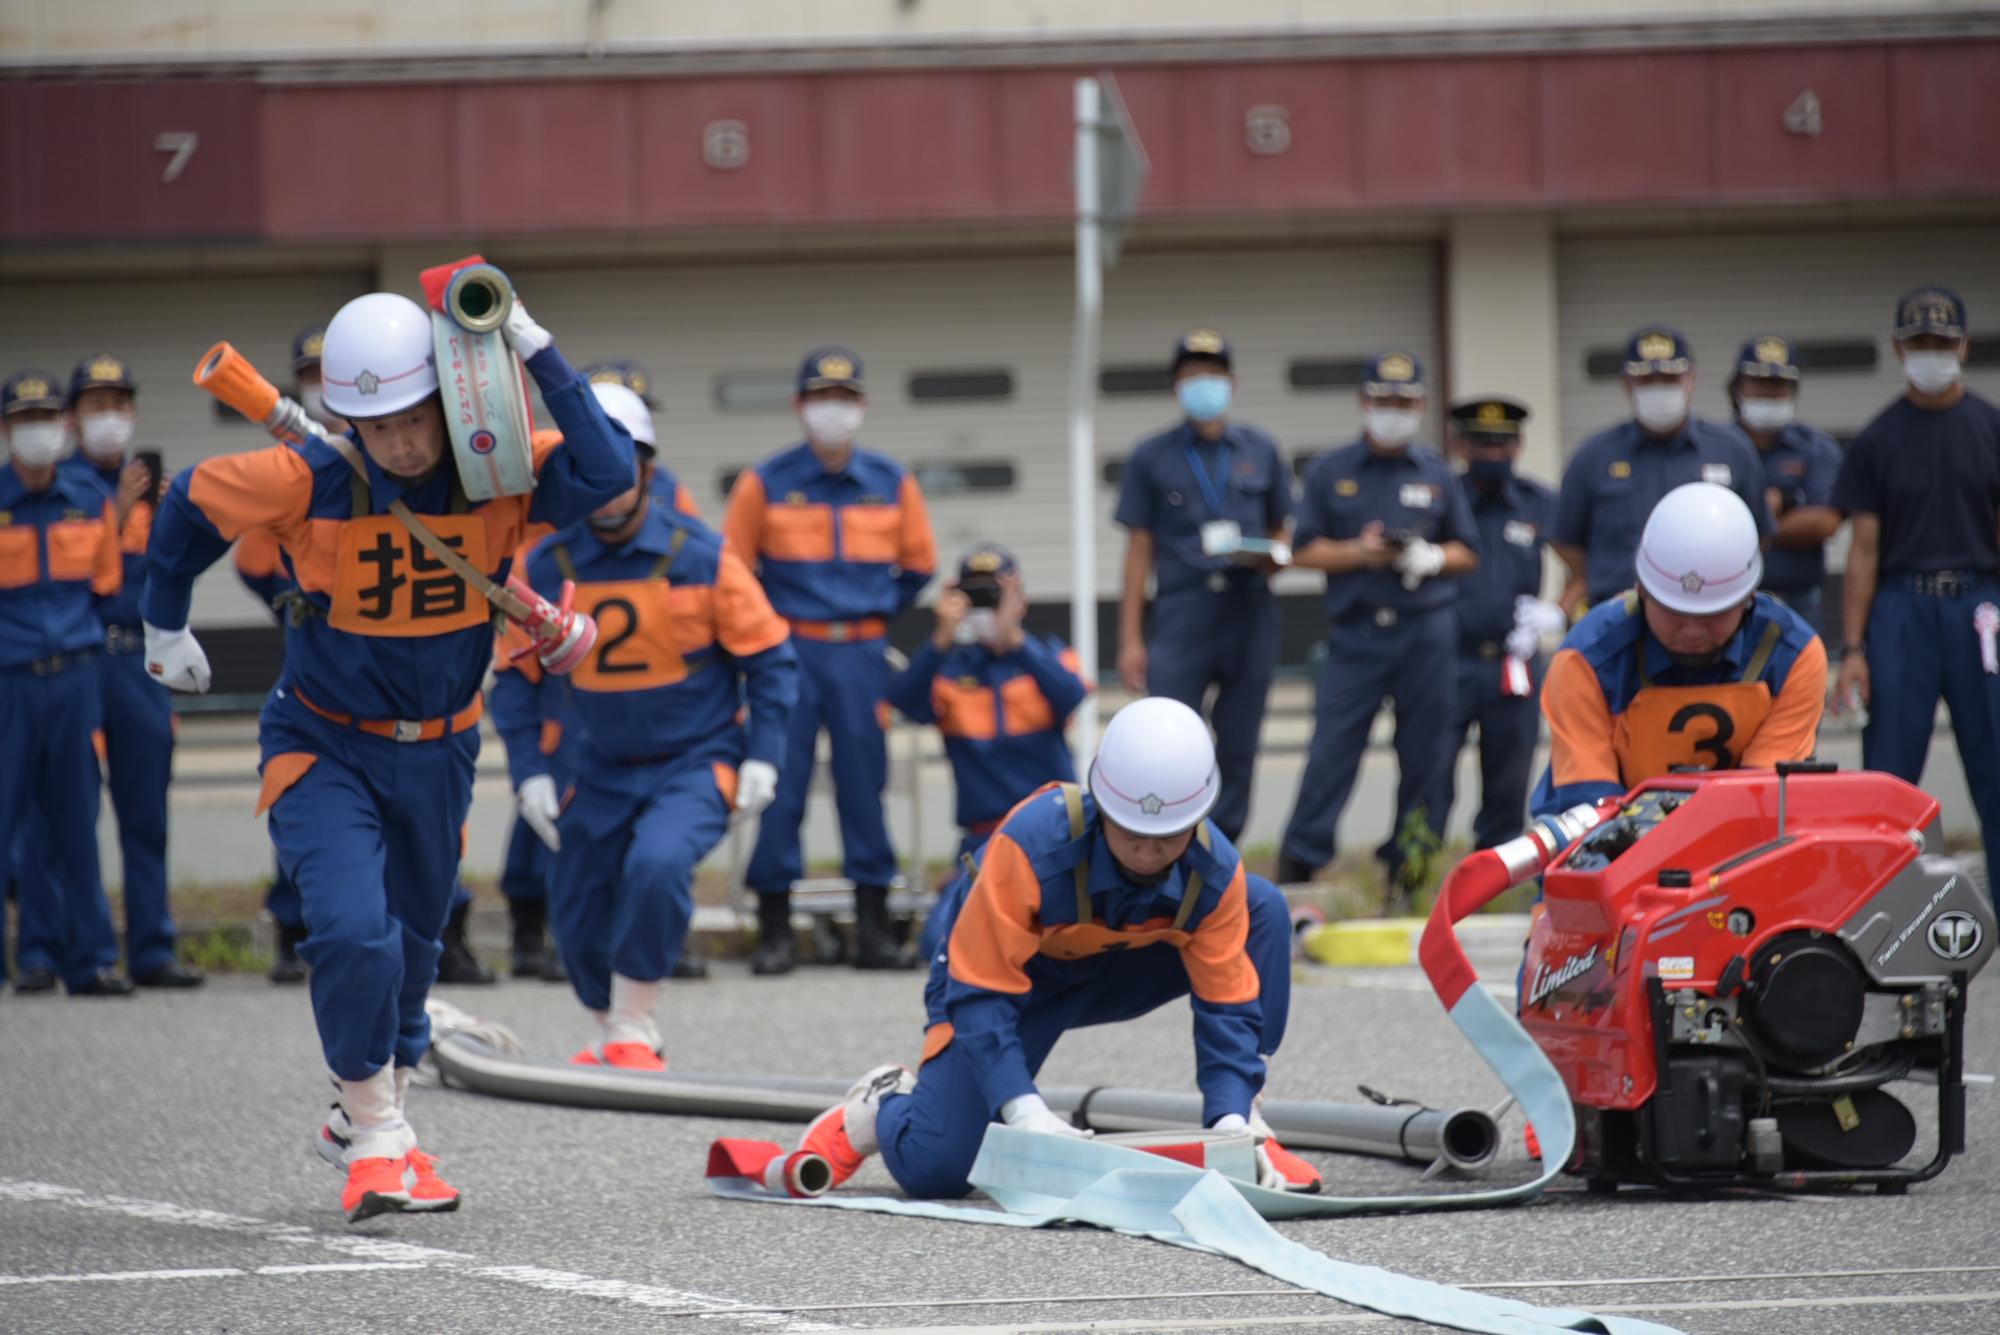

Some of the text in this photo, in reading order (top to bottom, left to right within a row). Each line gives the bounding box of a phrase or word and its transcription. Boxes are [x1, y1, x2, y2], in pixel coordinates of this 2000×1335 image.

[153, 132, 198, 182] 7
[702, 119, 748, 168] 6
[1245, 104, 1291, 154] 5
[358, 533, 468, 620] 指
[593, 598, 648, 673] 2
[1668, 703, 1734, 772] 3
[1878, 874, 1957, 967] Twin Vacuum Pump
[1528, 943, 1597, 1006] Limited
